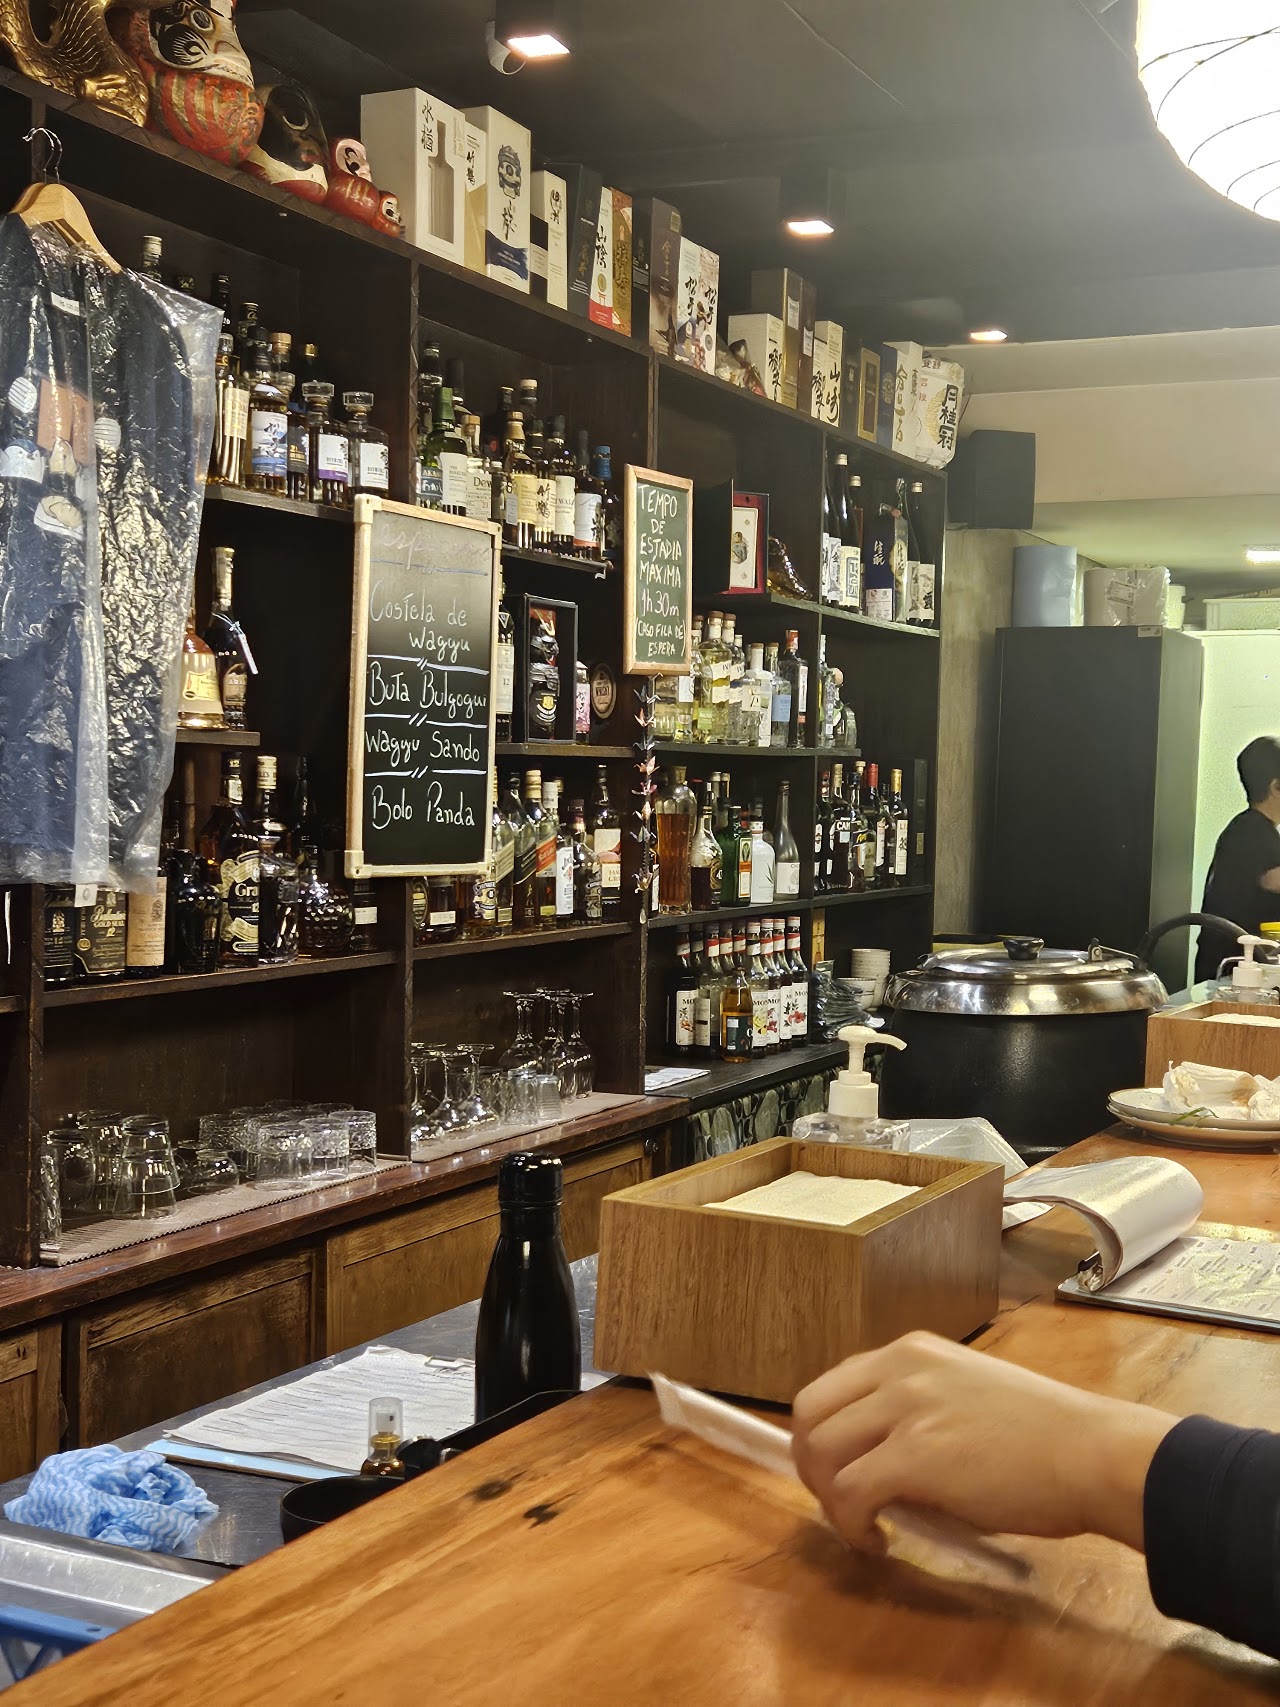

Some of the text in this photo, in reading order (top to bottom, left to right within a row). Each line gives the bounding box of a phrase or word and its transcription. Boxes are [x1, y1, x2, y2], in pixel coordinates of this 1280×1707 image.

[937, 384, 959, 451] 月桂冠
[638, 484, 678, 518] TEMPO
[651, 518, 666, 535] DE
[640, 533, 682, 561] ESTADIA
[639, 554, 682, 588] MÁXIMA
[370, 580, 467, 627] Costela de
[655, 590, 680, 618] 30m
[656, 623, 673, 639] FILA
[419, 669, 487, 719] Bulgogui
[429, 731, 480, 762] Sando
[371, 781, 476, 829] Bolo Panda
